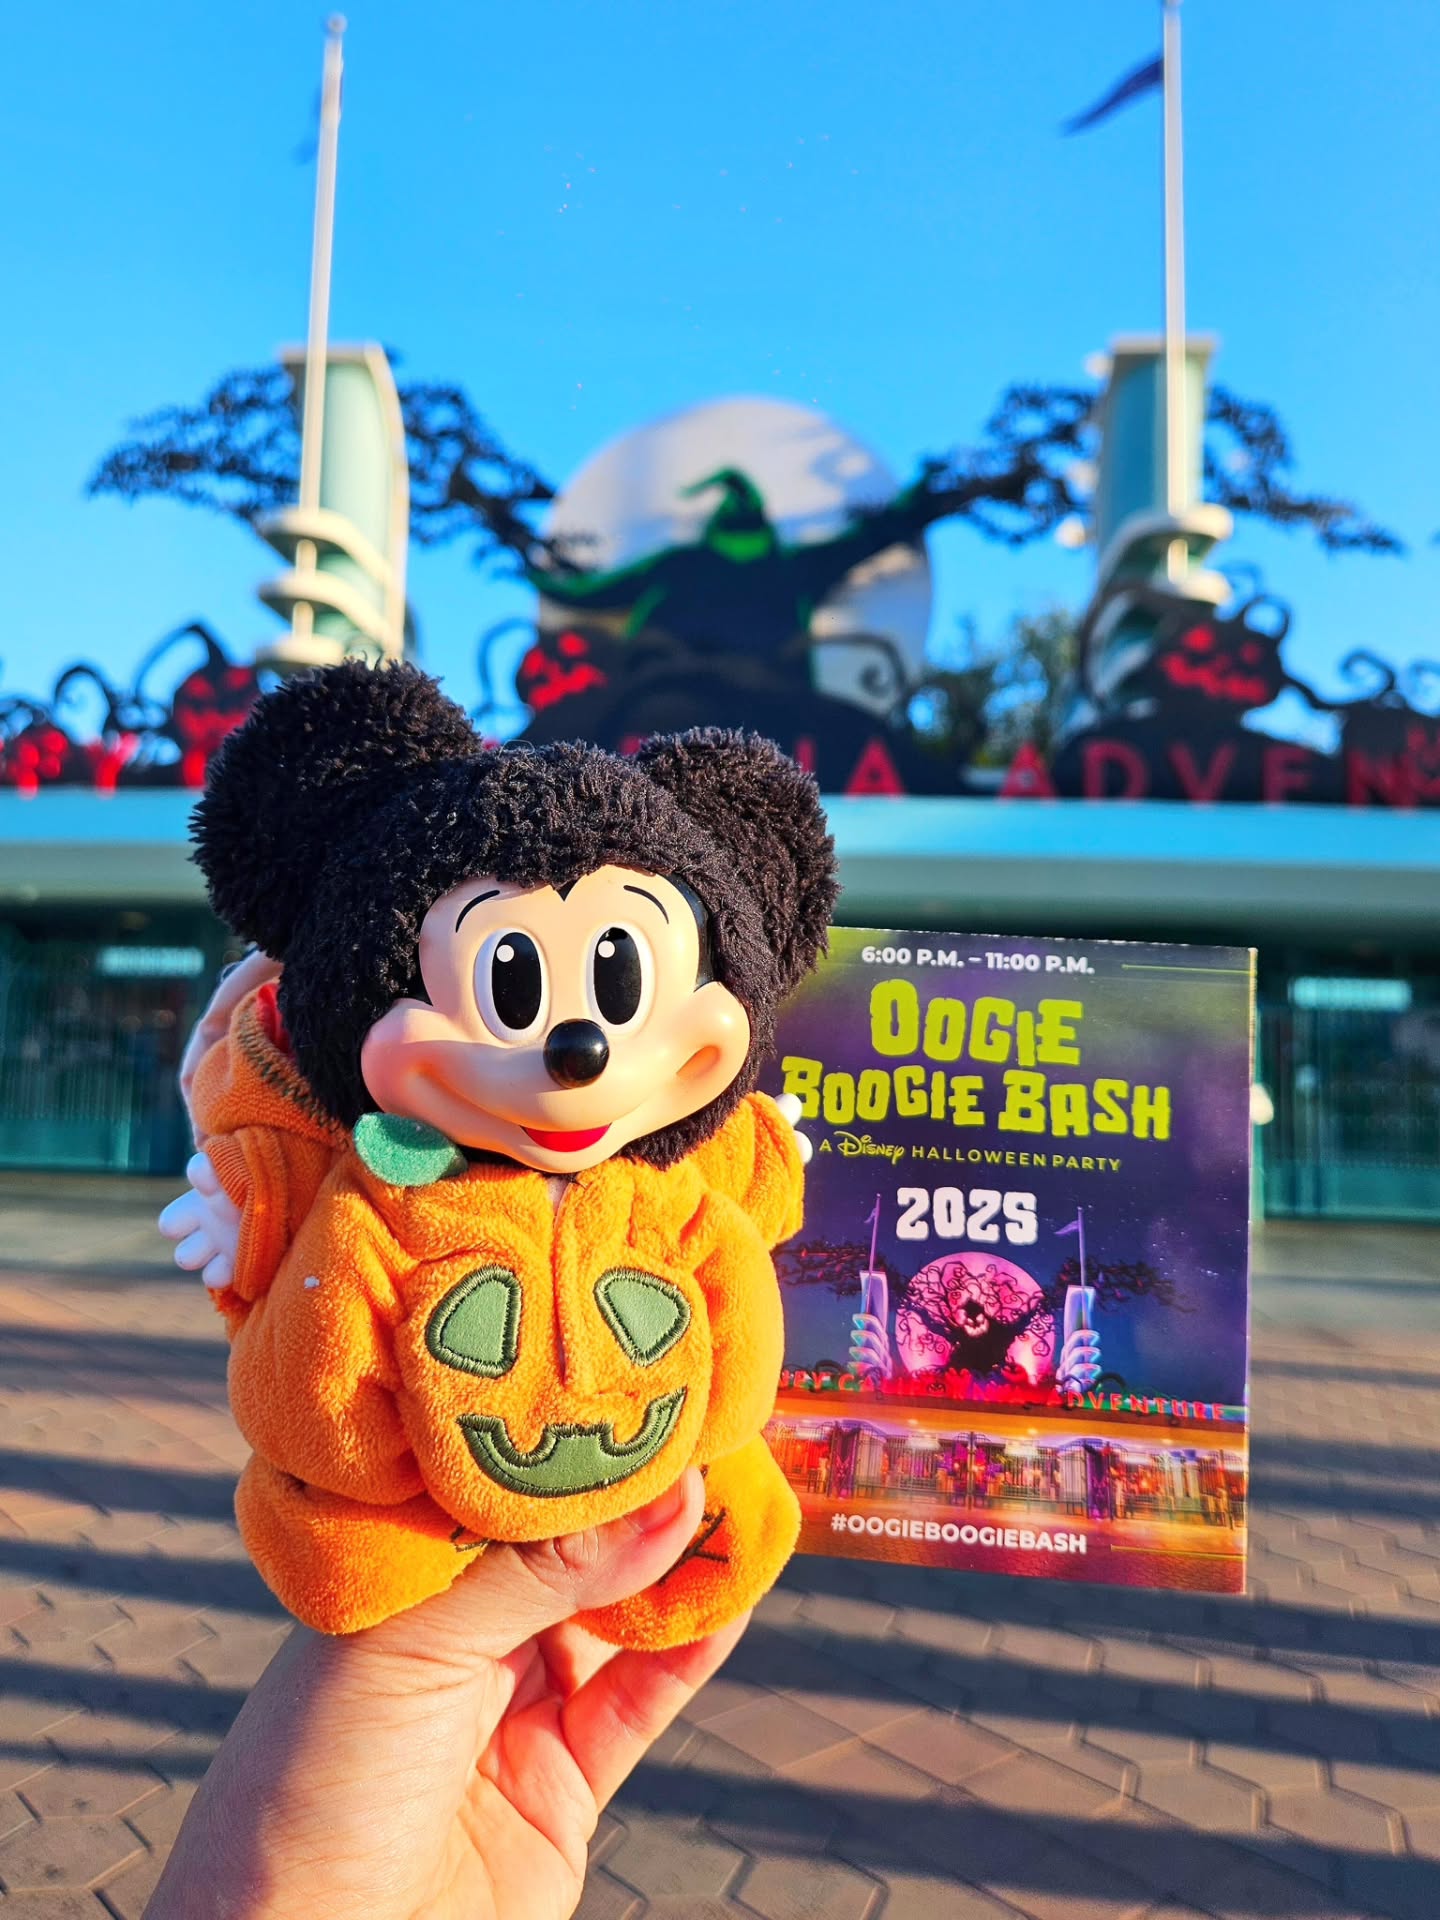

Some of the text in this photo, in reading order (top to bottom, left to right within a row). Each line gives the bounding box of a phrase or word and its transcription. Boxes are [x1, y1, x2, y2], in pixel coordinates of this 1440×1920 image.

[861, 945, 912, 965] 6:00
[916, 948, 964, 968] P.M.
[985, 951, 1041, 972] 11:00
[1045, 955, 1096, 975] P.M.
[869, 978, 1083, 1067] OOGIE
[781, 1056, 1171, 1140] BOOGIE BASH
[819, 1131, 1122, 1171] A Disney HALLOWEEN PARTY
[895, 1186, 1038, 1245] 2025
[831, 1513, 1087, 1555] #OOGIEBOOGIEBASH
